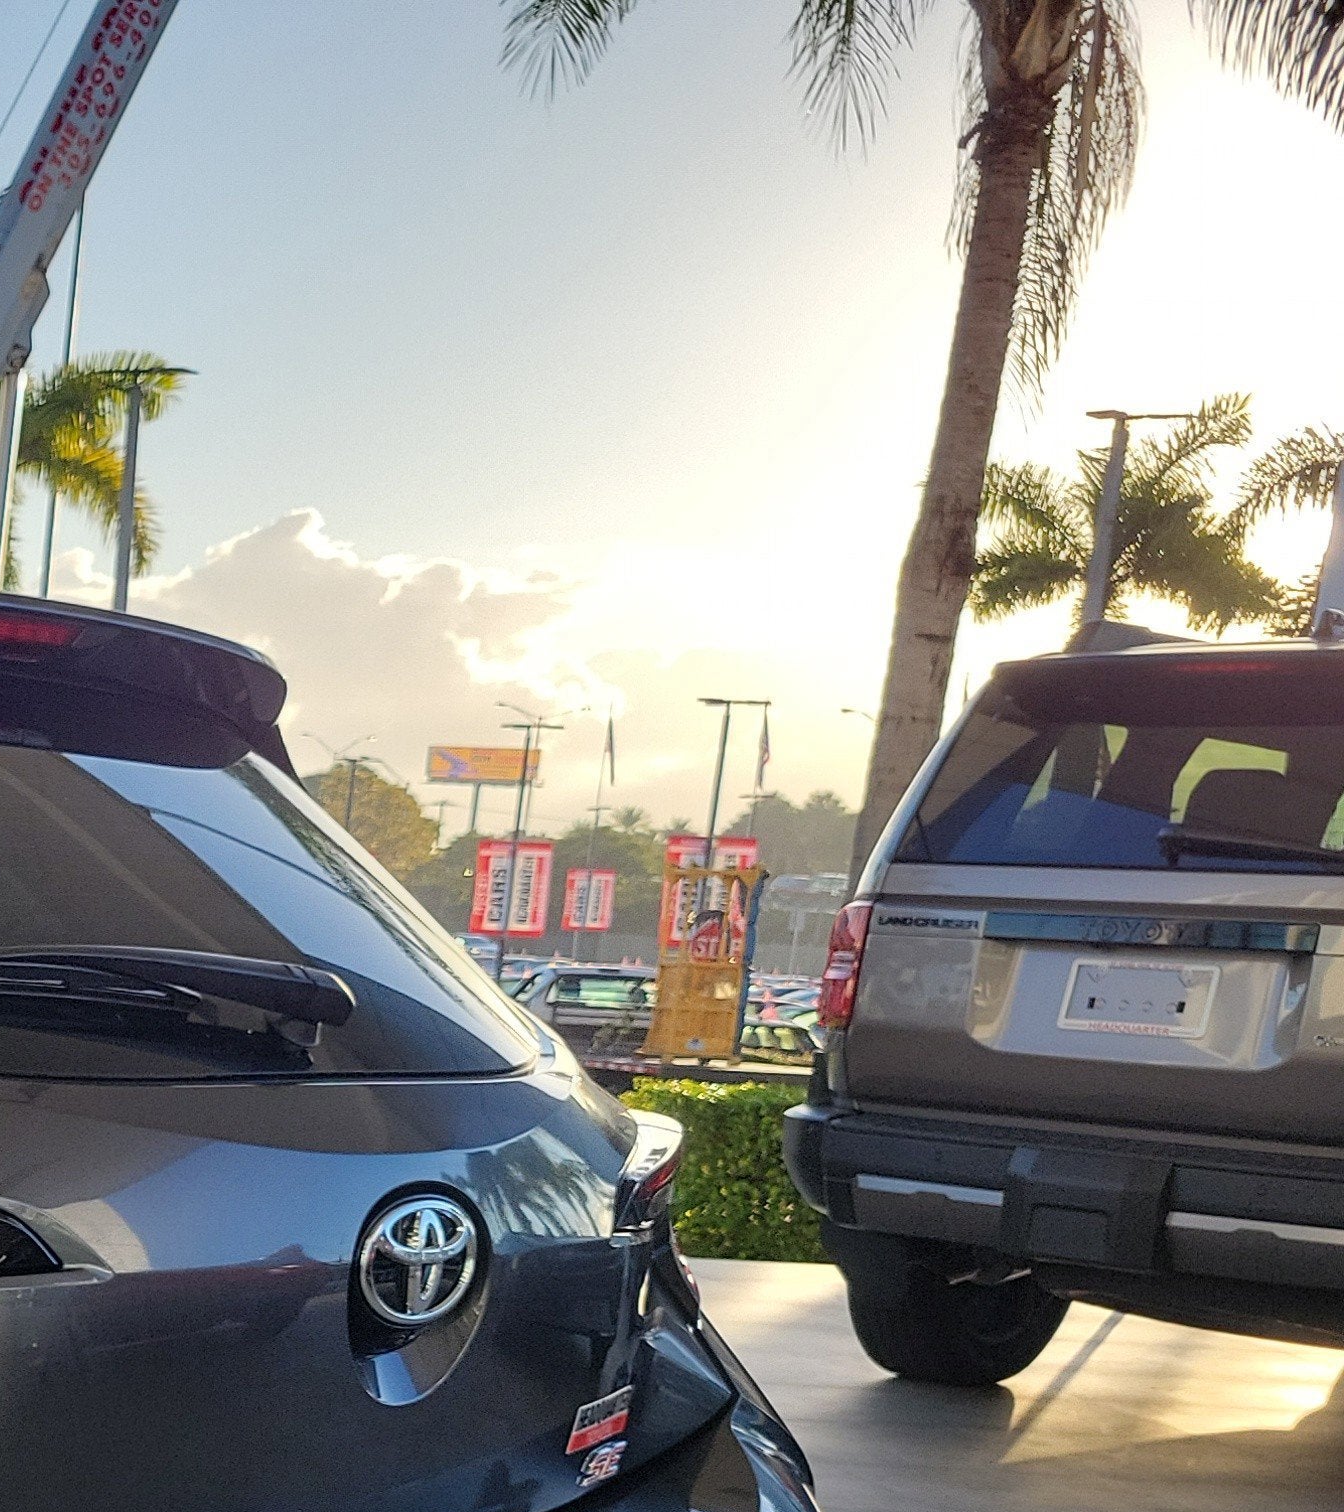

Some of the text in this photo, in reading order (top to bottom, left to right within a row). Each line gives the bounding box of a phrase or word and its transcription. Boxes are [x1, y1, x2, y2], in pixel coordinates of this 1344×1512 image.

[28, 173, 54, 213] ON
[50, 122, 78, 167] THE
[74, 53, 113, 118] SPOT
[109, 0, 144, 48] SER
[1088, 1021, 1171, 1036] HEADQUARTER
